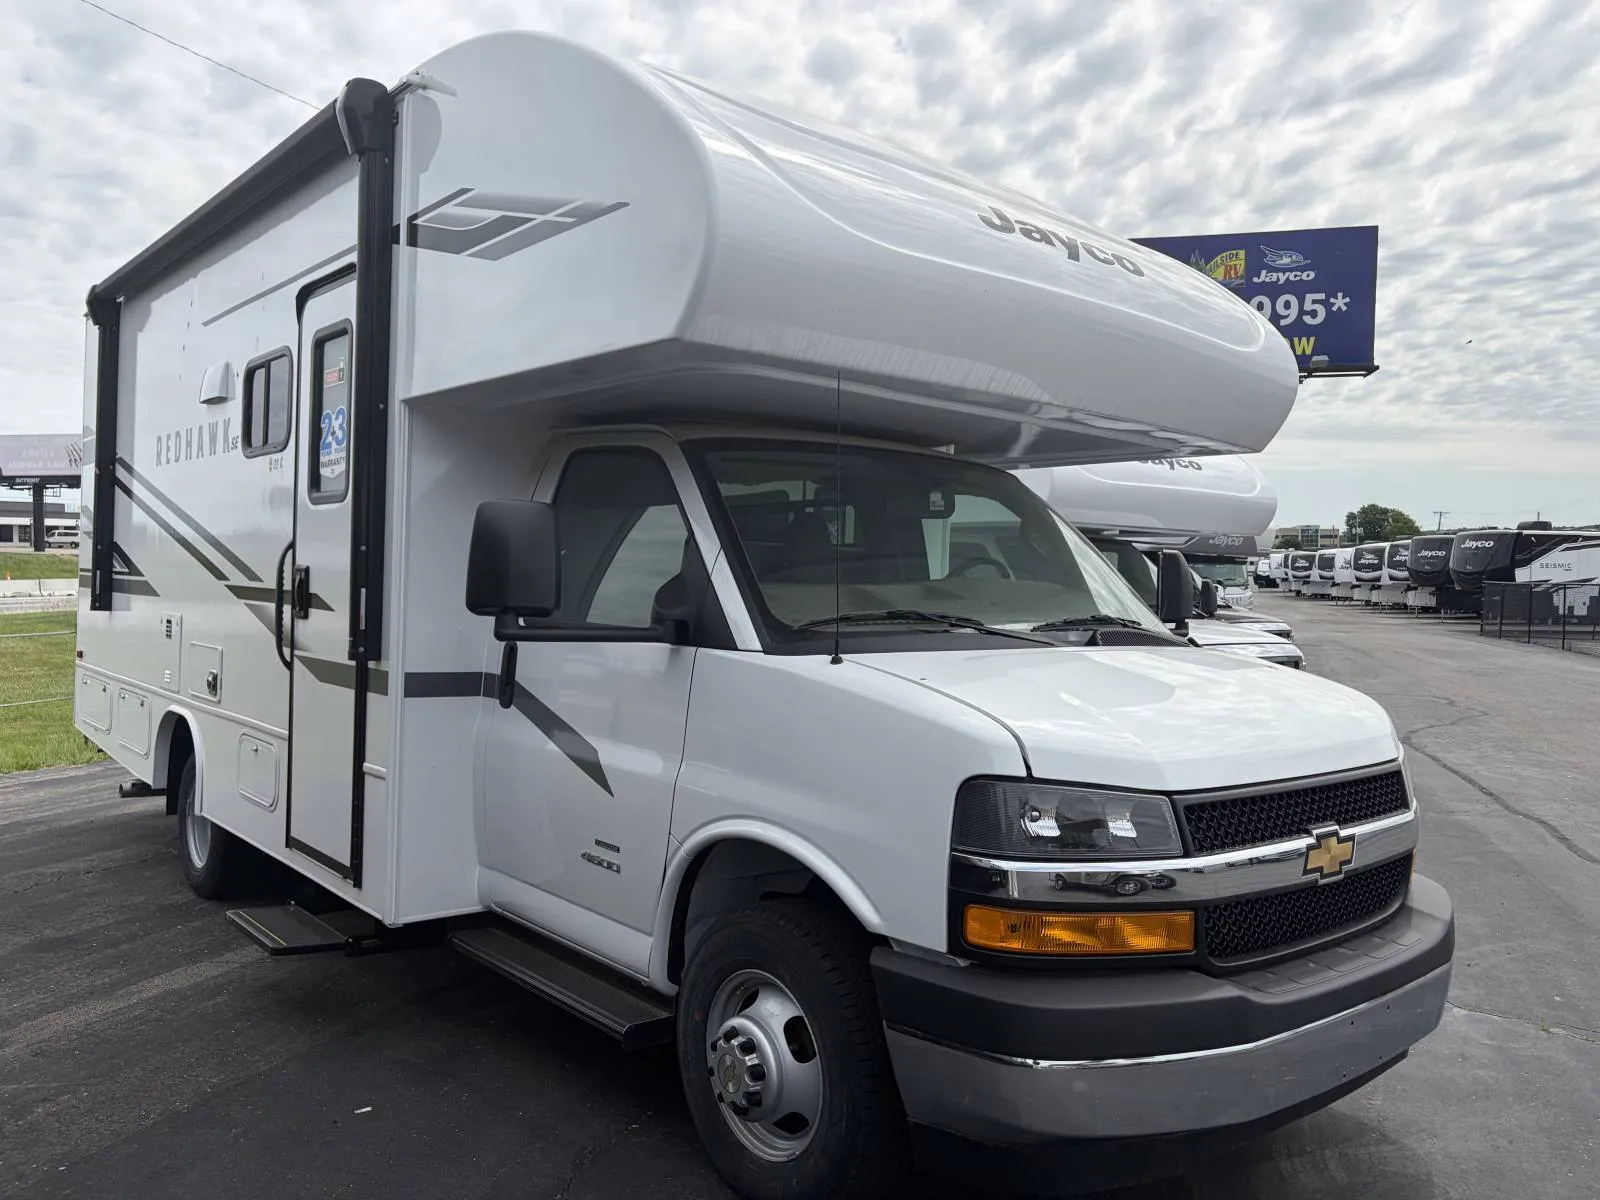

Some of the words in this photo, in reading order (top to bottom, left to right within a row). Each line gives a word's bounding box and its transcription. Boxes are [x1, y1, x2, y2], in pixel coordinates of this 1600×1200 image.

[976, 205, 1145, 277] Jayco
[1223, 263, 1241, 280] RV
[1252, 269, 1316, 284] Jayco
[156, 416, 231, 467] REDHAWK
[1209, 535, 1244, 548] Jayco
[1461, 539, 1494, 549] Jayco
[1418, 549, 1446, 558] Jayco
[580, 851, 621, 874] 4500
